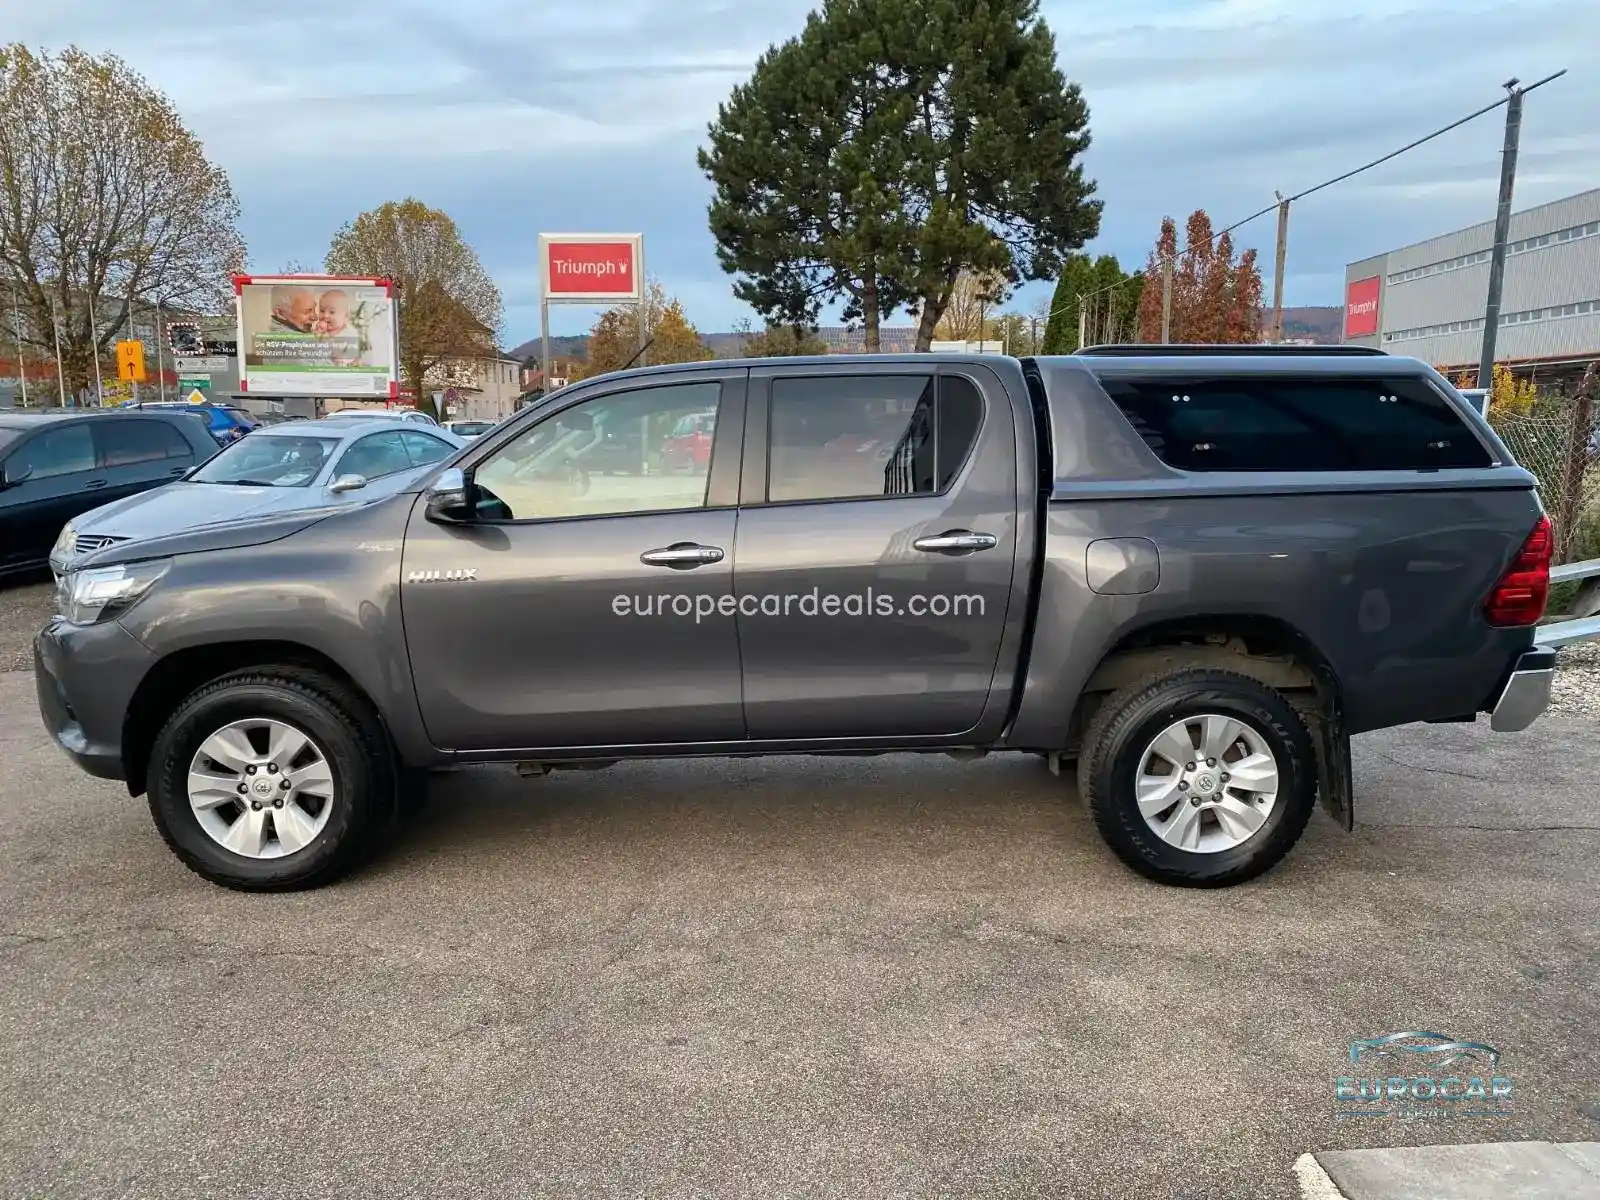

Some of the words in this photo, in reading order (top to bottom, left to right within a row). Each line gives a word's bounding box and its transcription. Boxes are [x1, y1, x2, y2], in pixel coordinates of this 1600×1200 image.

[553, 259, 615, 278] Triumph
[1348, 300, 1372, 316] Triumph
[126, 347, 133, 356] U
[408, 567, 478, 583] HILUX
